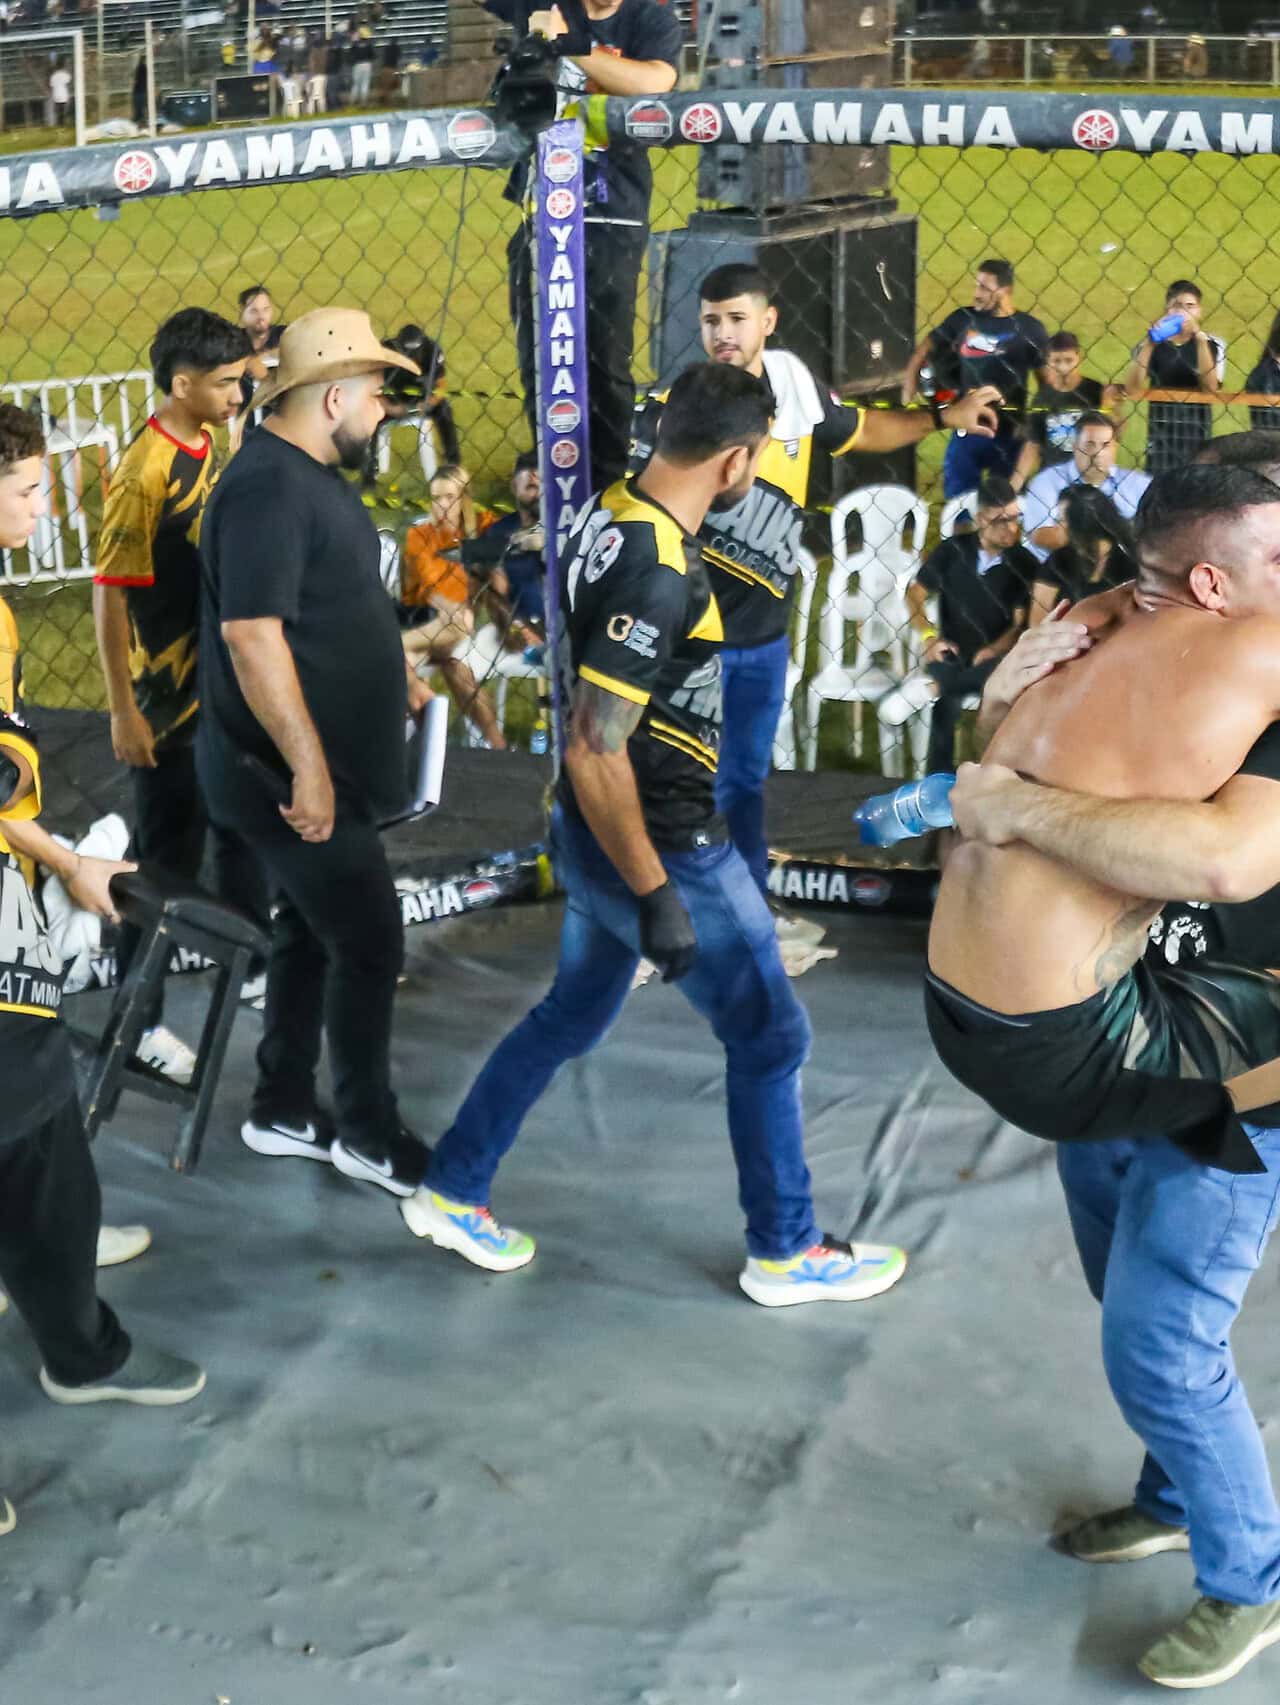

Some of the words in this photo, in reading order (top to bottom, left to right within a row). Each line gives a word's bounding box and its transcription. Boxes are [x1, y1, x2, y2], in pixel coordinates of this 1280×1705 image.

[153, 118, 441, 188] YAMAHA
[723, 102, 1020, 147] YAMAHA
[548, 225, 576, 395] YAMAHA
